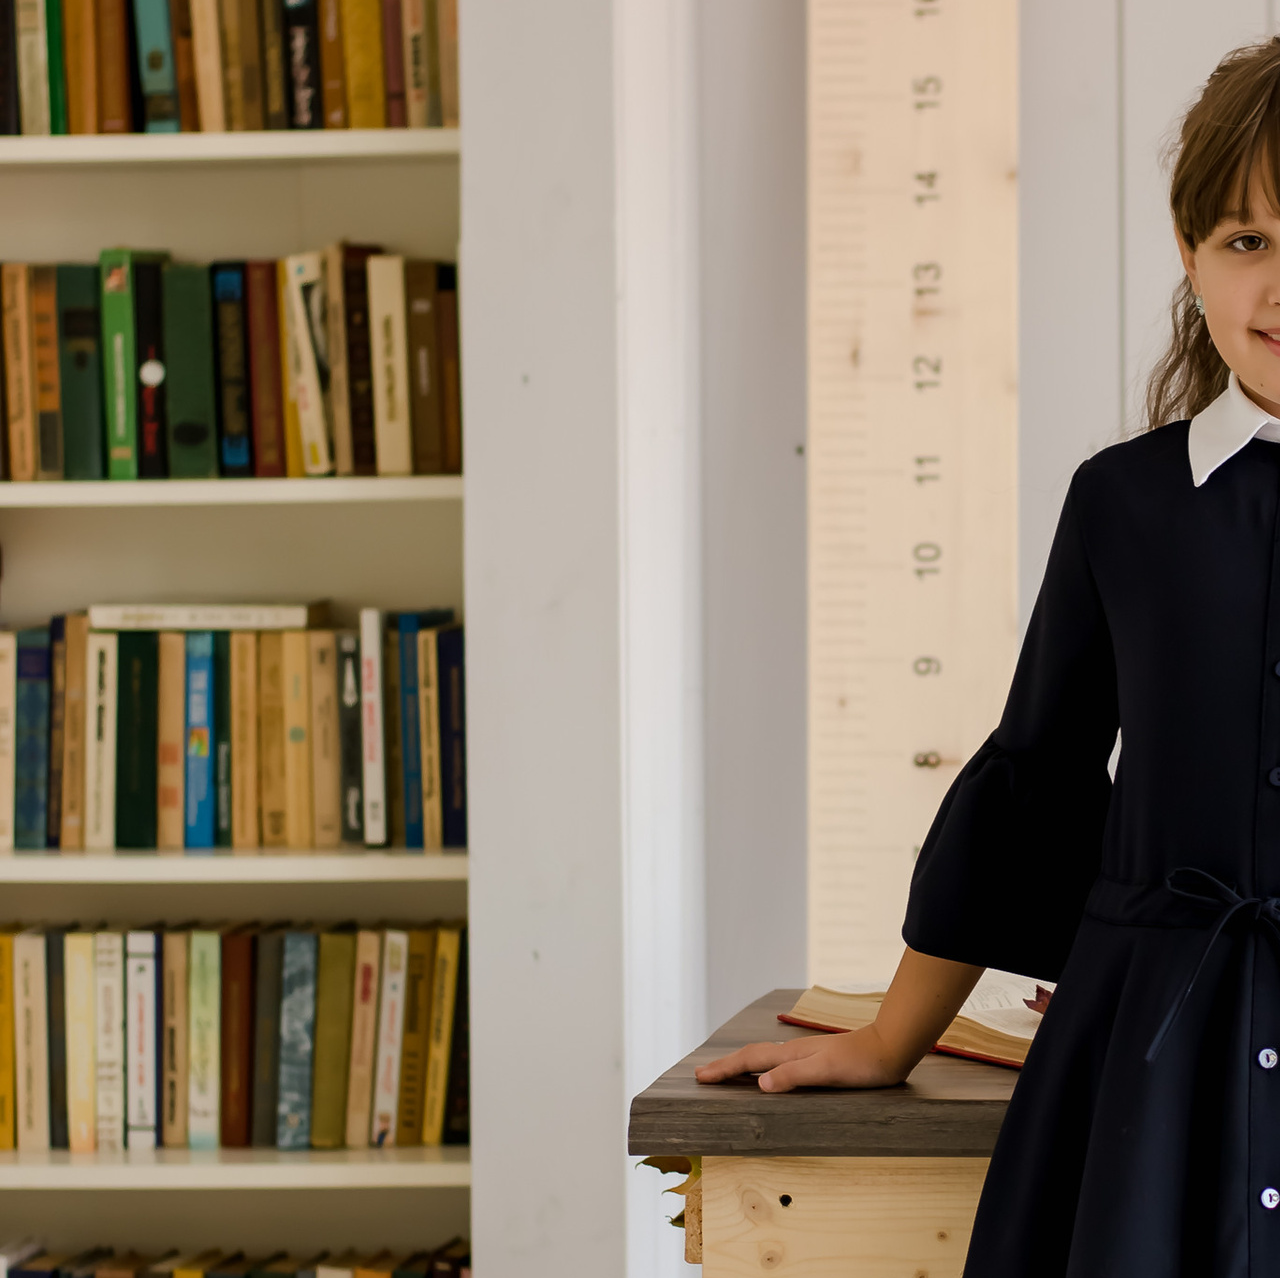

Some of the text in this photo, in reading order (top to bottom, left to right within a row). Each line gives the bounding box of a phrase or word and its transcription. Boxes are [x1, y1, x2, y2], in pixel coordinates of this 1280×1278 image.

[911, 75, 942, 112] 15
[912, 170, 940, 205] 14
[912, 262, 942, 296] 13
[912, 354, 942, 392] 12
[912, 454, 941, 485] 11
[912, 541, 943, 580] 10
[912, 655, 942, 677] 9
[913, 751, 941, 769] 8
